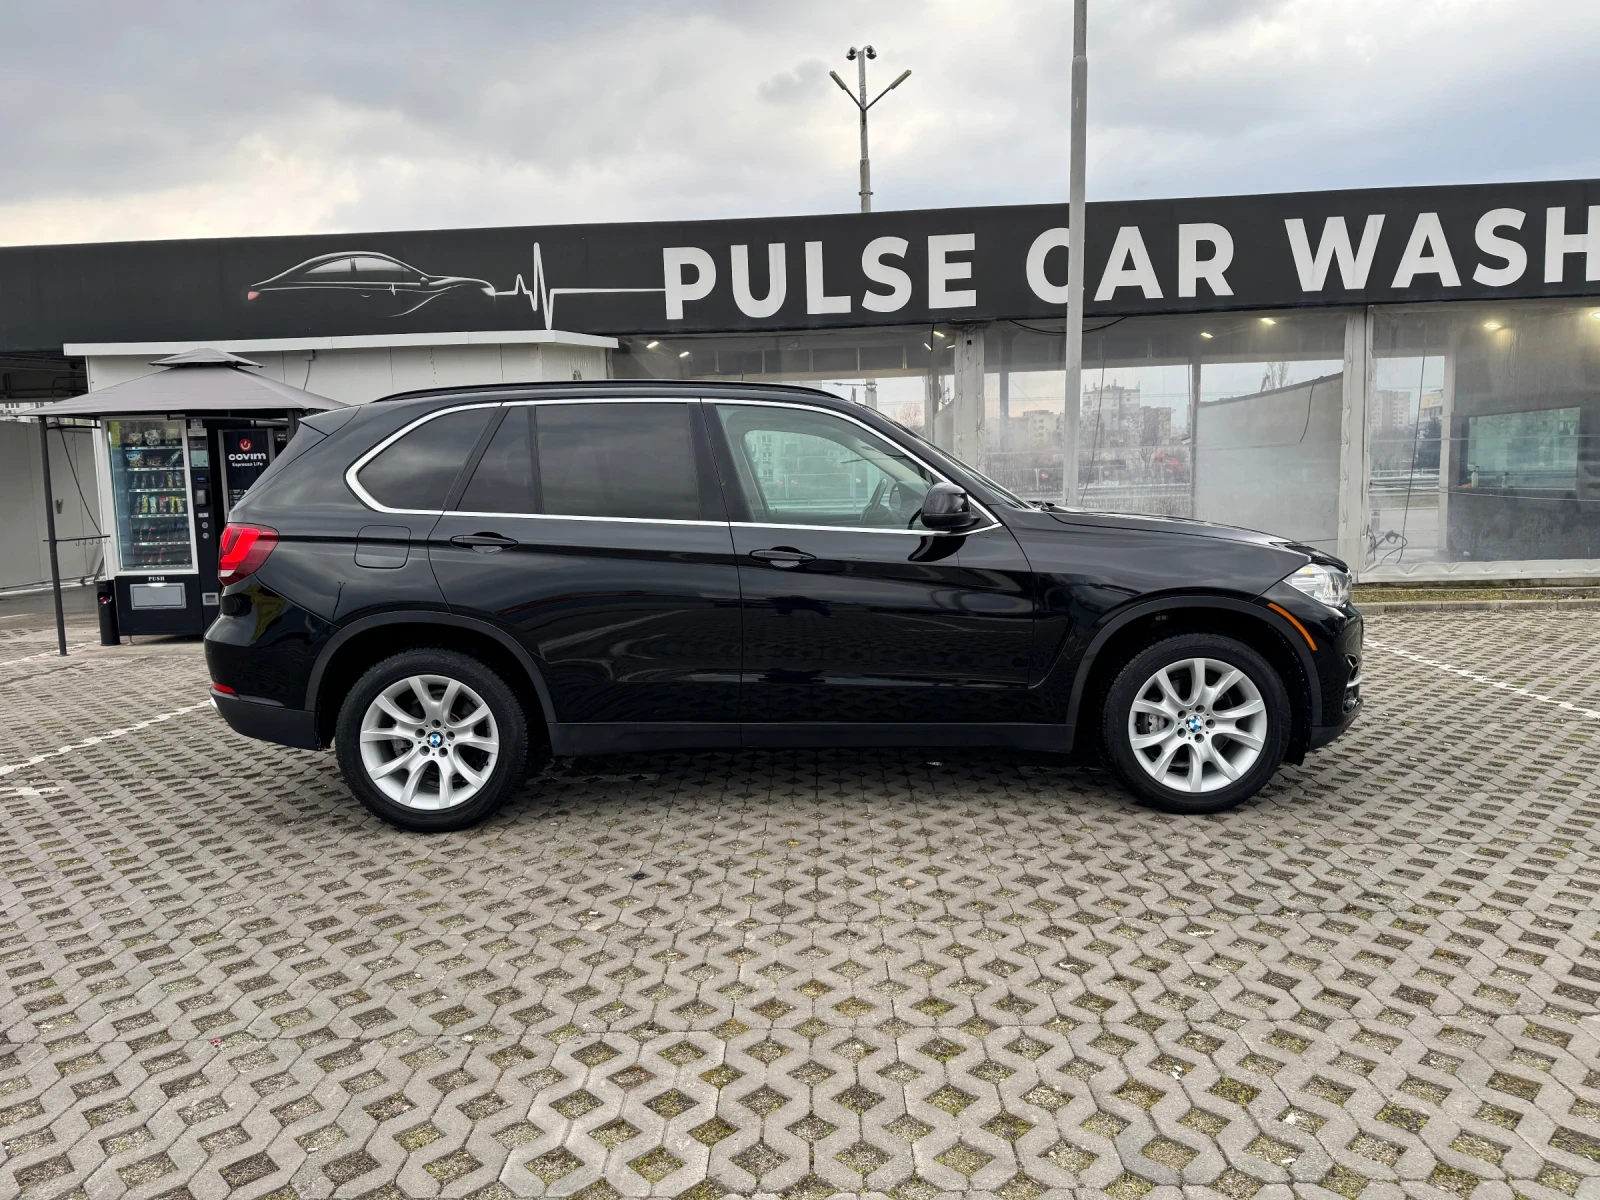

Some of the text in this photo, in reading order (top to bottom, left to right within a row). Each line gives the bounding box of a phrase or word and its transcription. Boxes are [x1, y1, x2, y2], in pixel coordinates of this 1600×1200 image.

[663, 204, 1600, 320] PULSE CAR WASH
